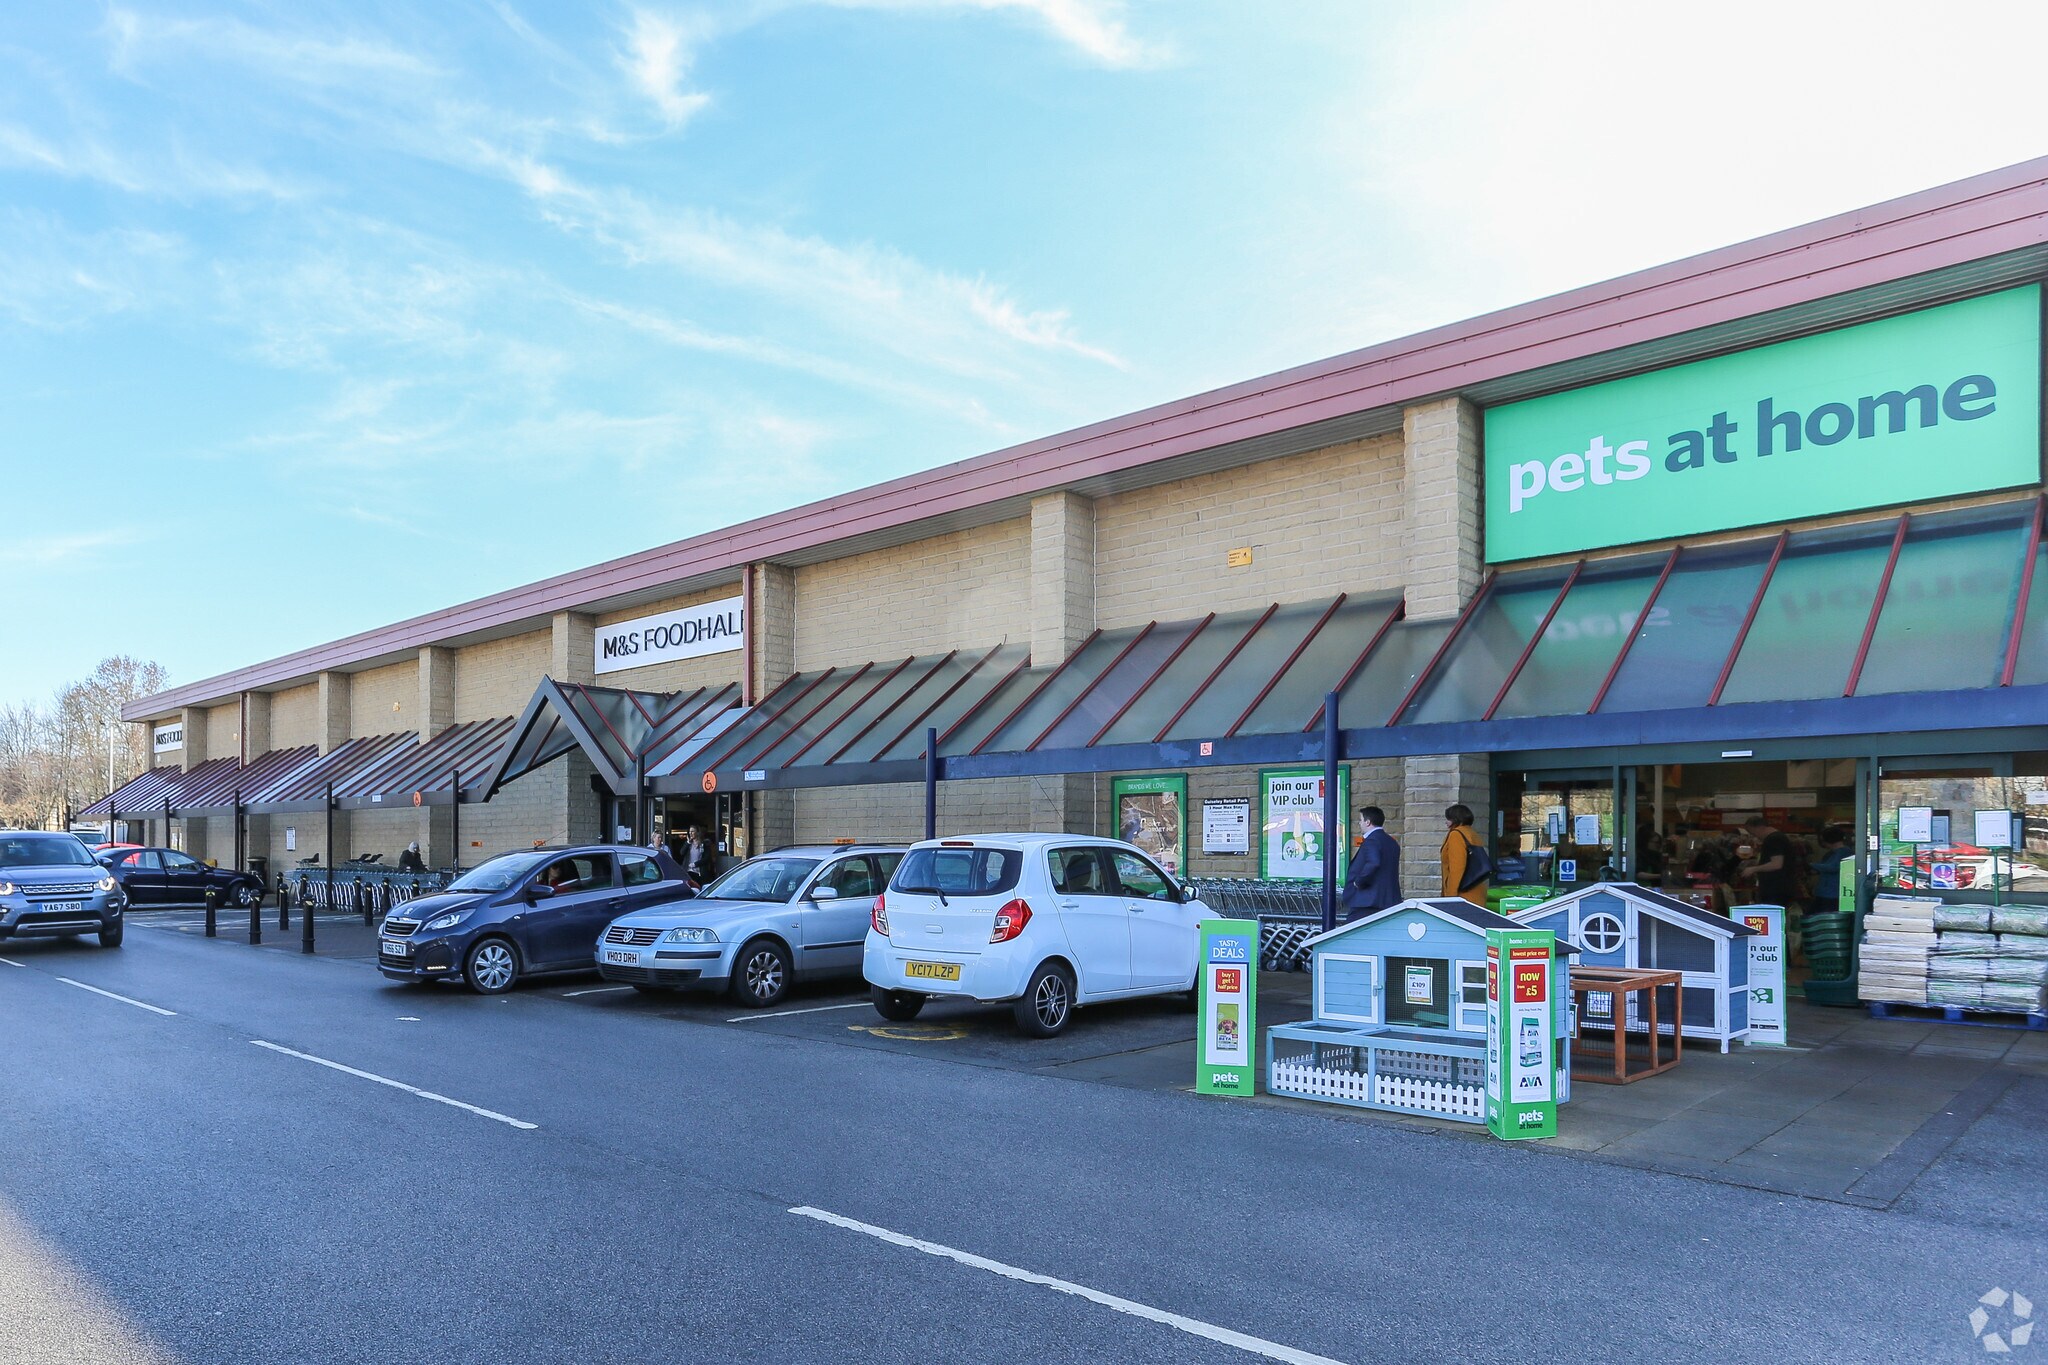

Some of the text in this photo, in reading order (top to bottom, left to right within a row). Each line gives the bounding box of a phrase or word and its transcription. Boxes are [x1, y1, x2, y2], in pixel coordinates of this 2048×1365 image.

[1509, 374, 1997, 514] pets at home
[603, 632, 639, 659] M&S
[1271, 780, 1292, 794] join
[1295, 781, 1314, 791] our
[1271, 794, 1315, 806] VIP club
[43, 903, 63, 911] YA67
[1218, 939, 1239, 948] TASTY
[607, 951, 637, 964] VH03 DRH
[1212, 947, 1245, 959] DEALS
[1756, 953, 1778, 962] club
[911, 963, 954, 978] YC17 LZP
[1519, 972, 1540, 982] now
[1525, 984, 1538, 997] £5
[1212, 1072, 1240, 1084] pets
[1519, 1076, 1543, 1088] AVA
[1518, 1109, 1544, 1124] pets
[1526, 1121, 1543, 1129] home
